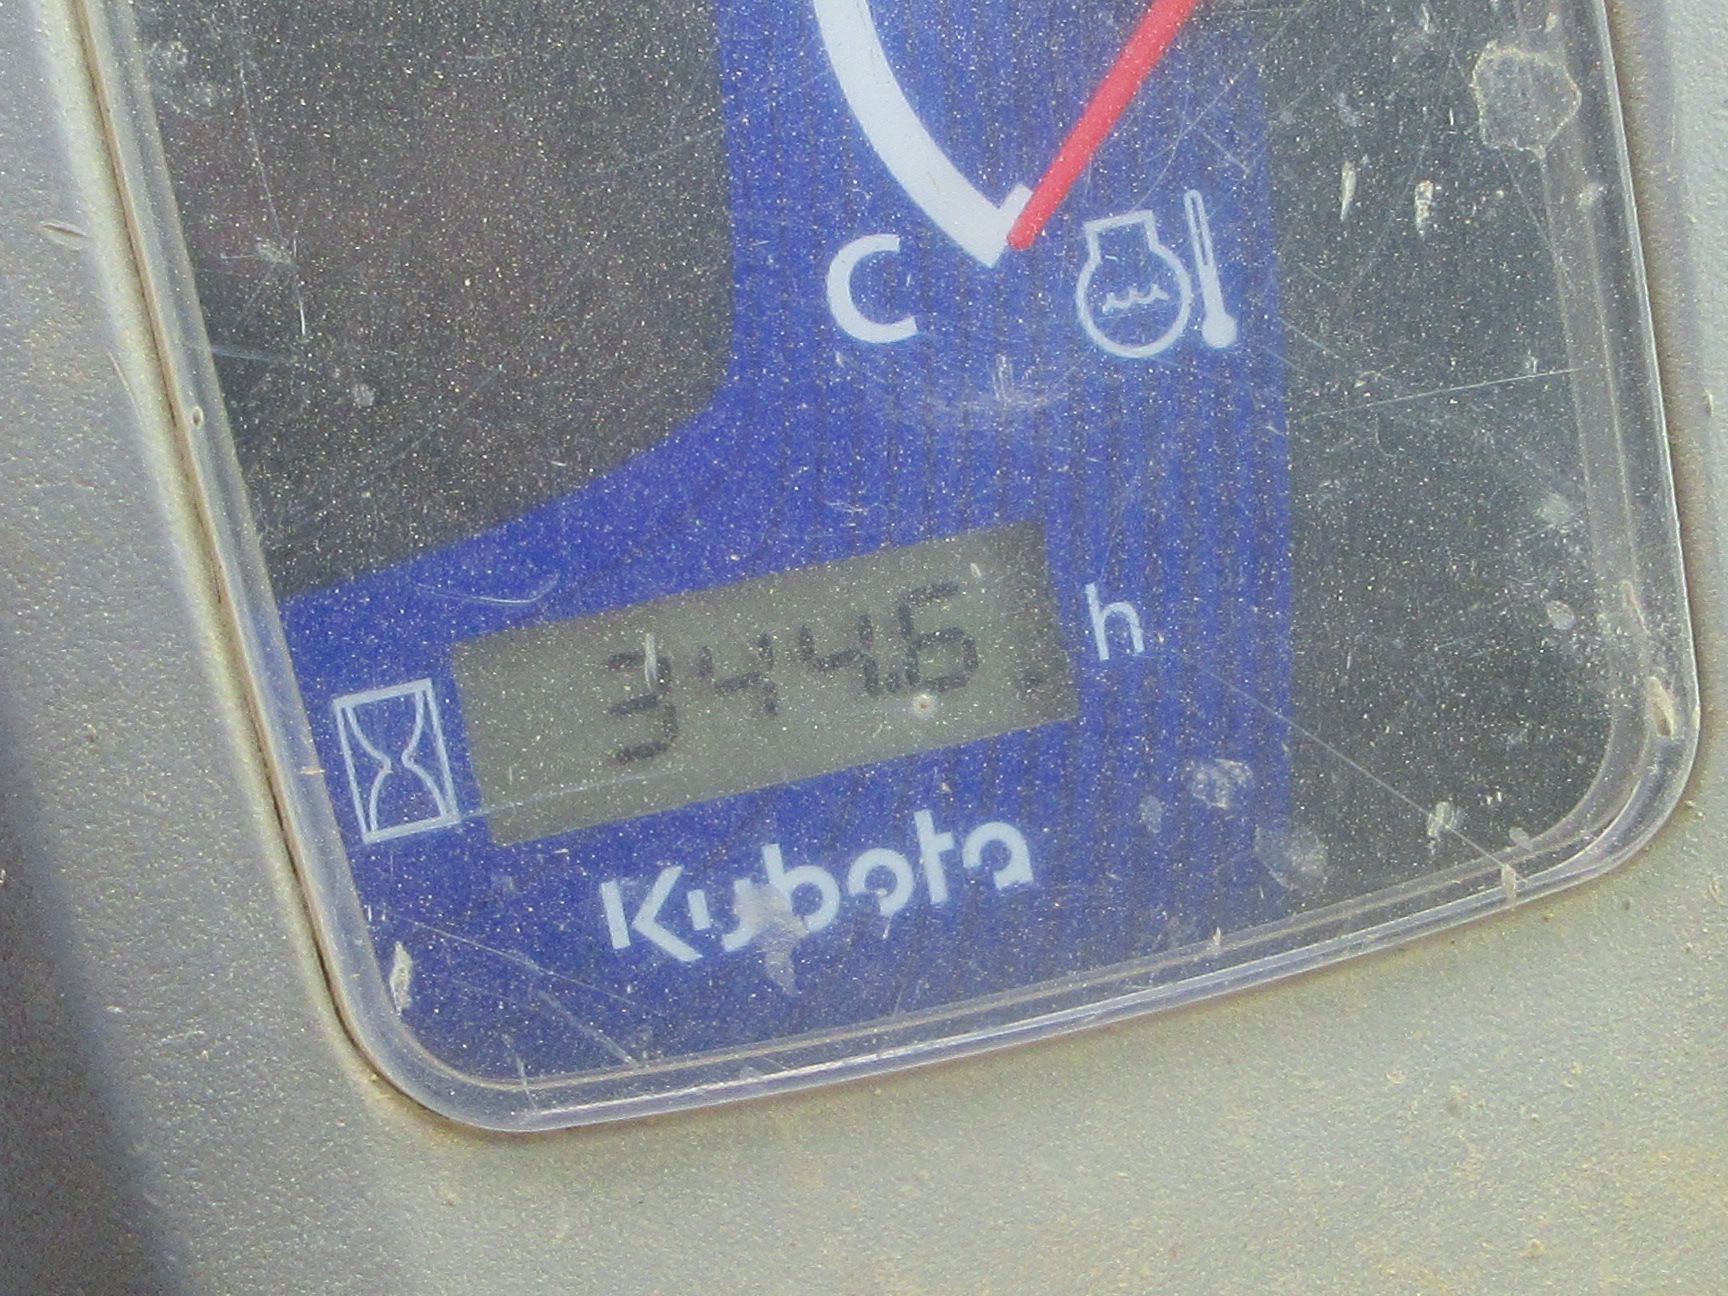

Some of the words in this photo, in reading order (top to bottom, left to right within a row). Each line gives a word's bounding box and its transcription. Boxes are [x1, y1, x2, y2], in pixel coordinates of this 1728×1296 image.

[826, 232, 920, 344] C
[1084, 582, 1146, 662] h
[599, 808, 1035, 963] Kubota
